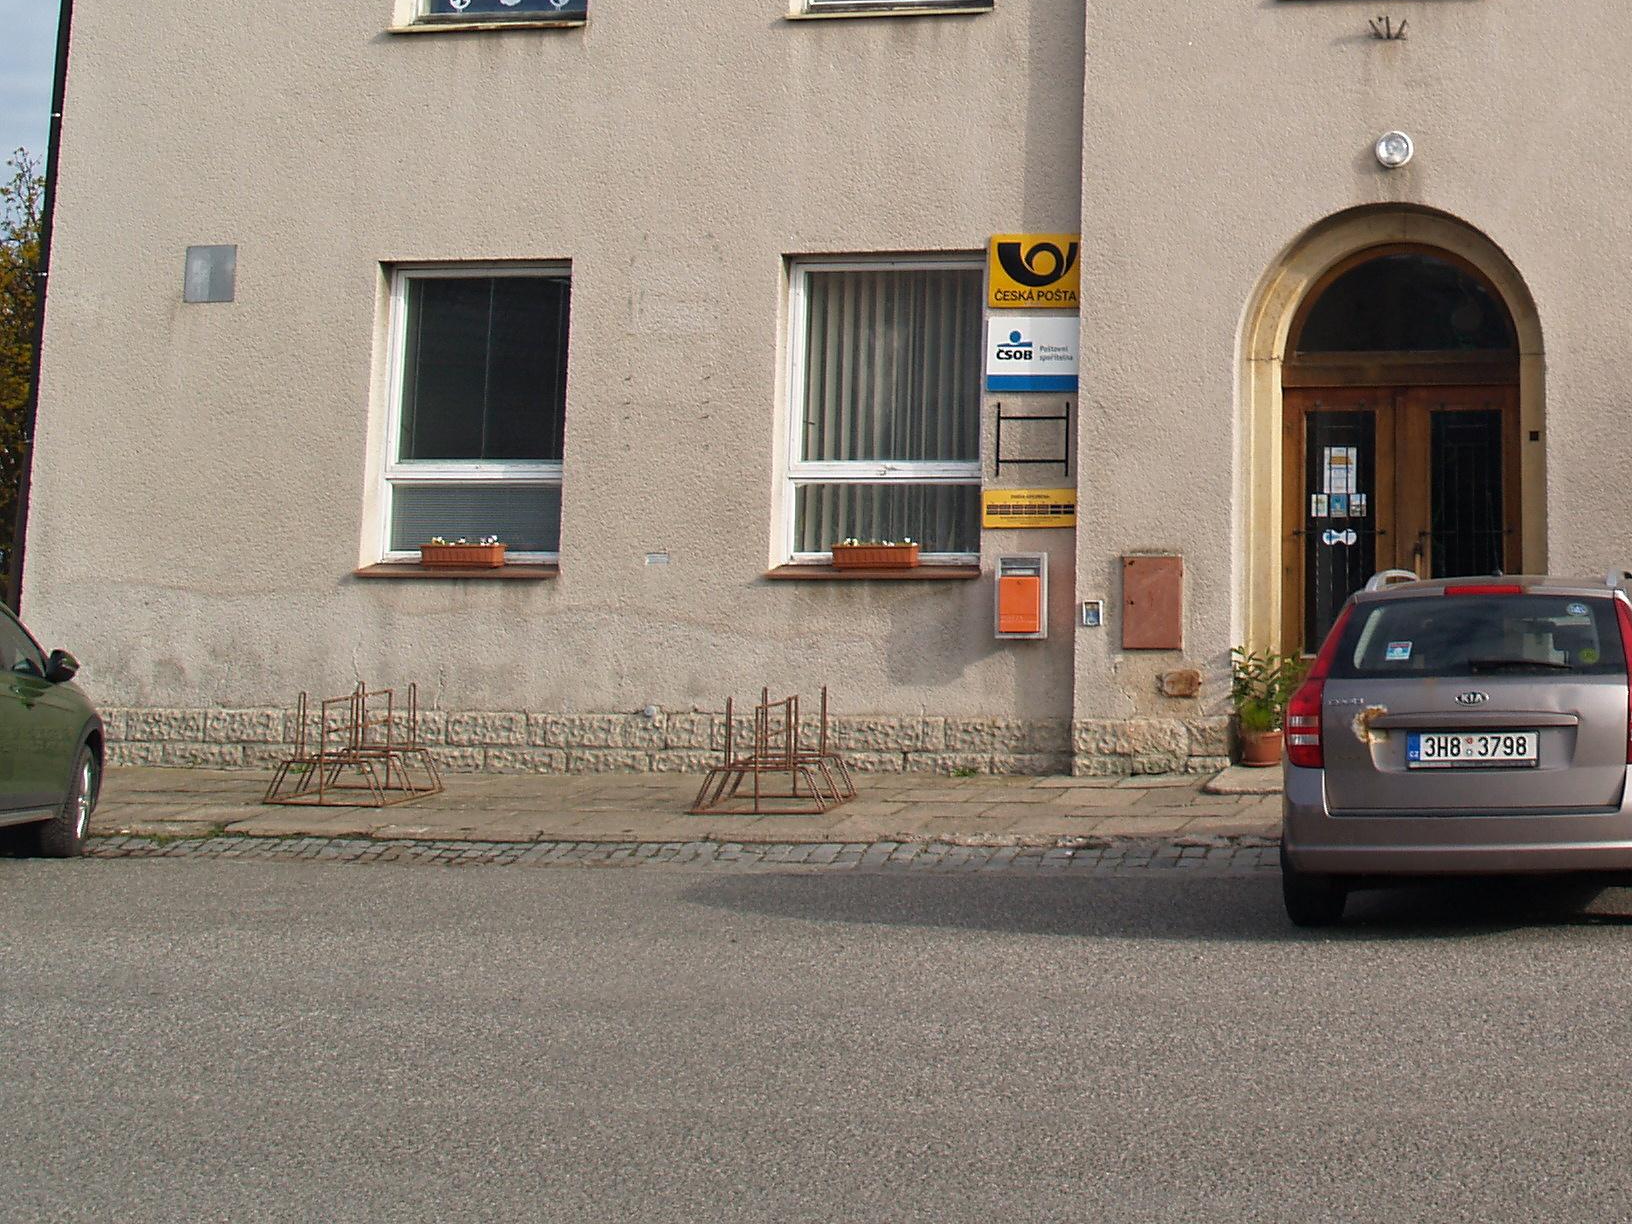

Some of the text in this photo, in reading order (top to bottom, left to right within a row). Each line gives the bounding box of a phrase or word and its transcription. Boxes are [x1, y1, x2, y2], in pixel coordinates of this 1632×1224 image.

[994, 288, 1077, 301] ČESKÁ POŠTA
[996, 349, 1033, 360] ČSOB
[1461, 693, 1483, 704] KIA
[1424, 735, 1527, 757] 3H8 3798
[1409, 750, 1419, 758] CZ
